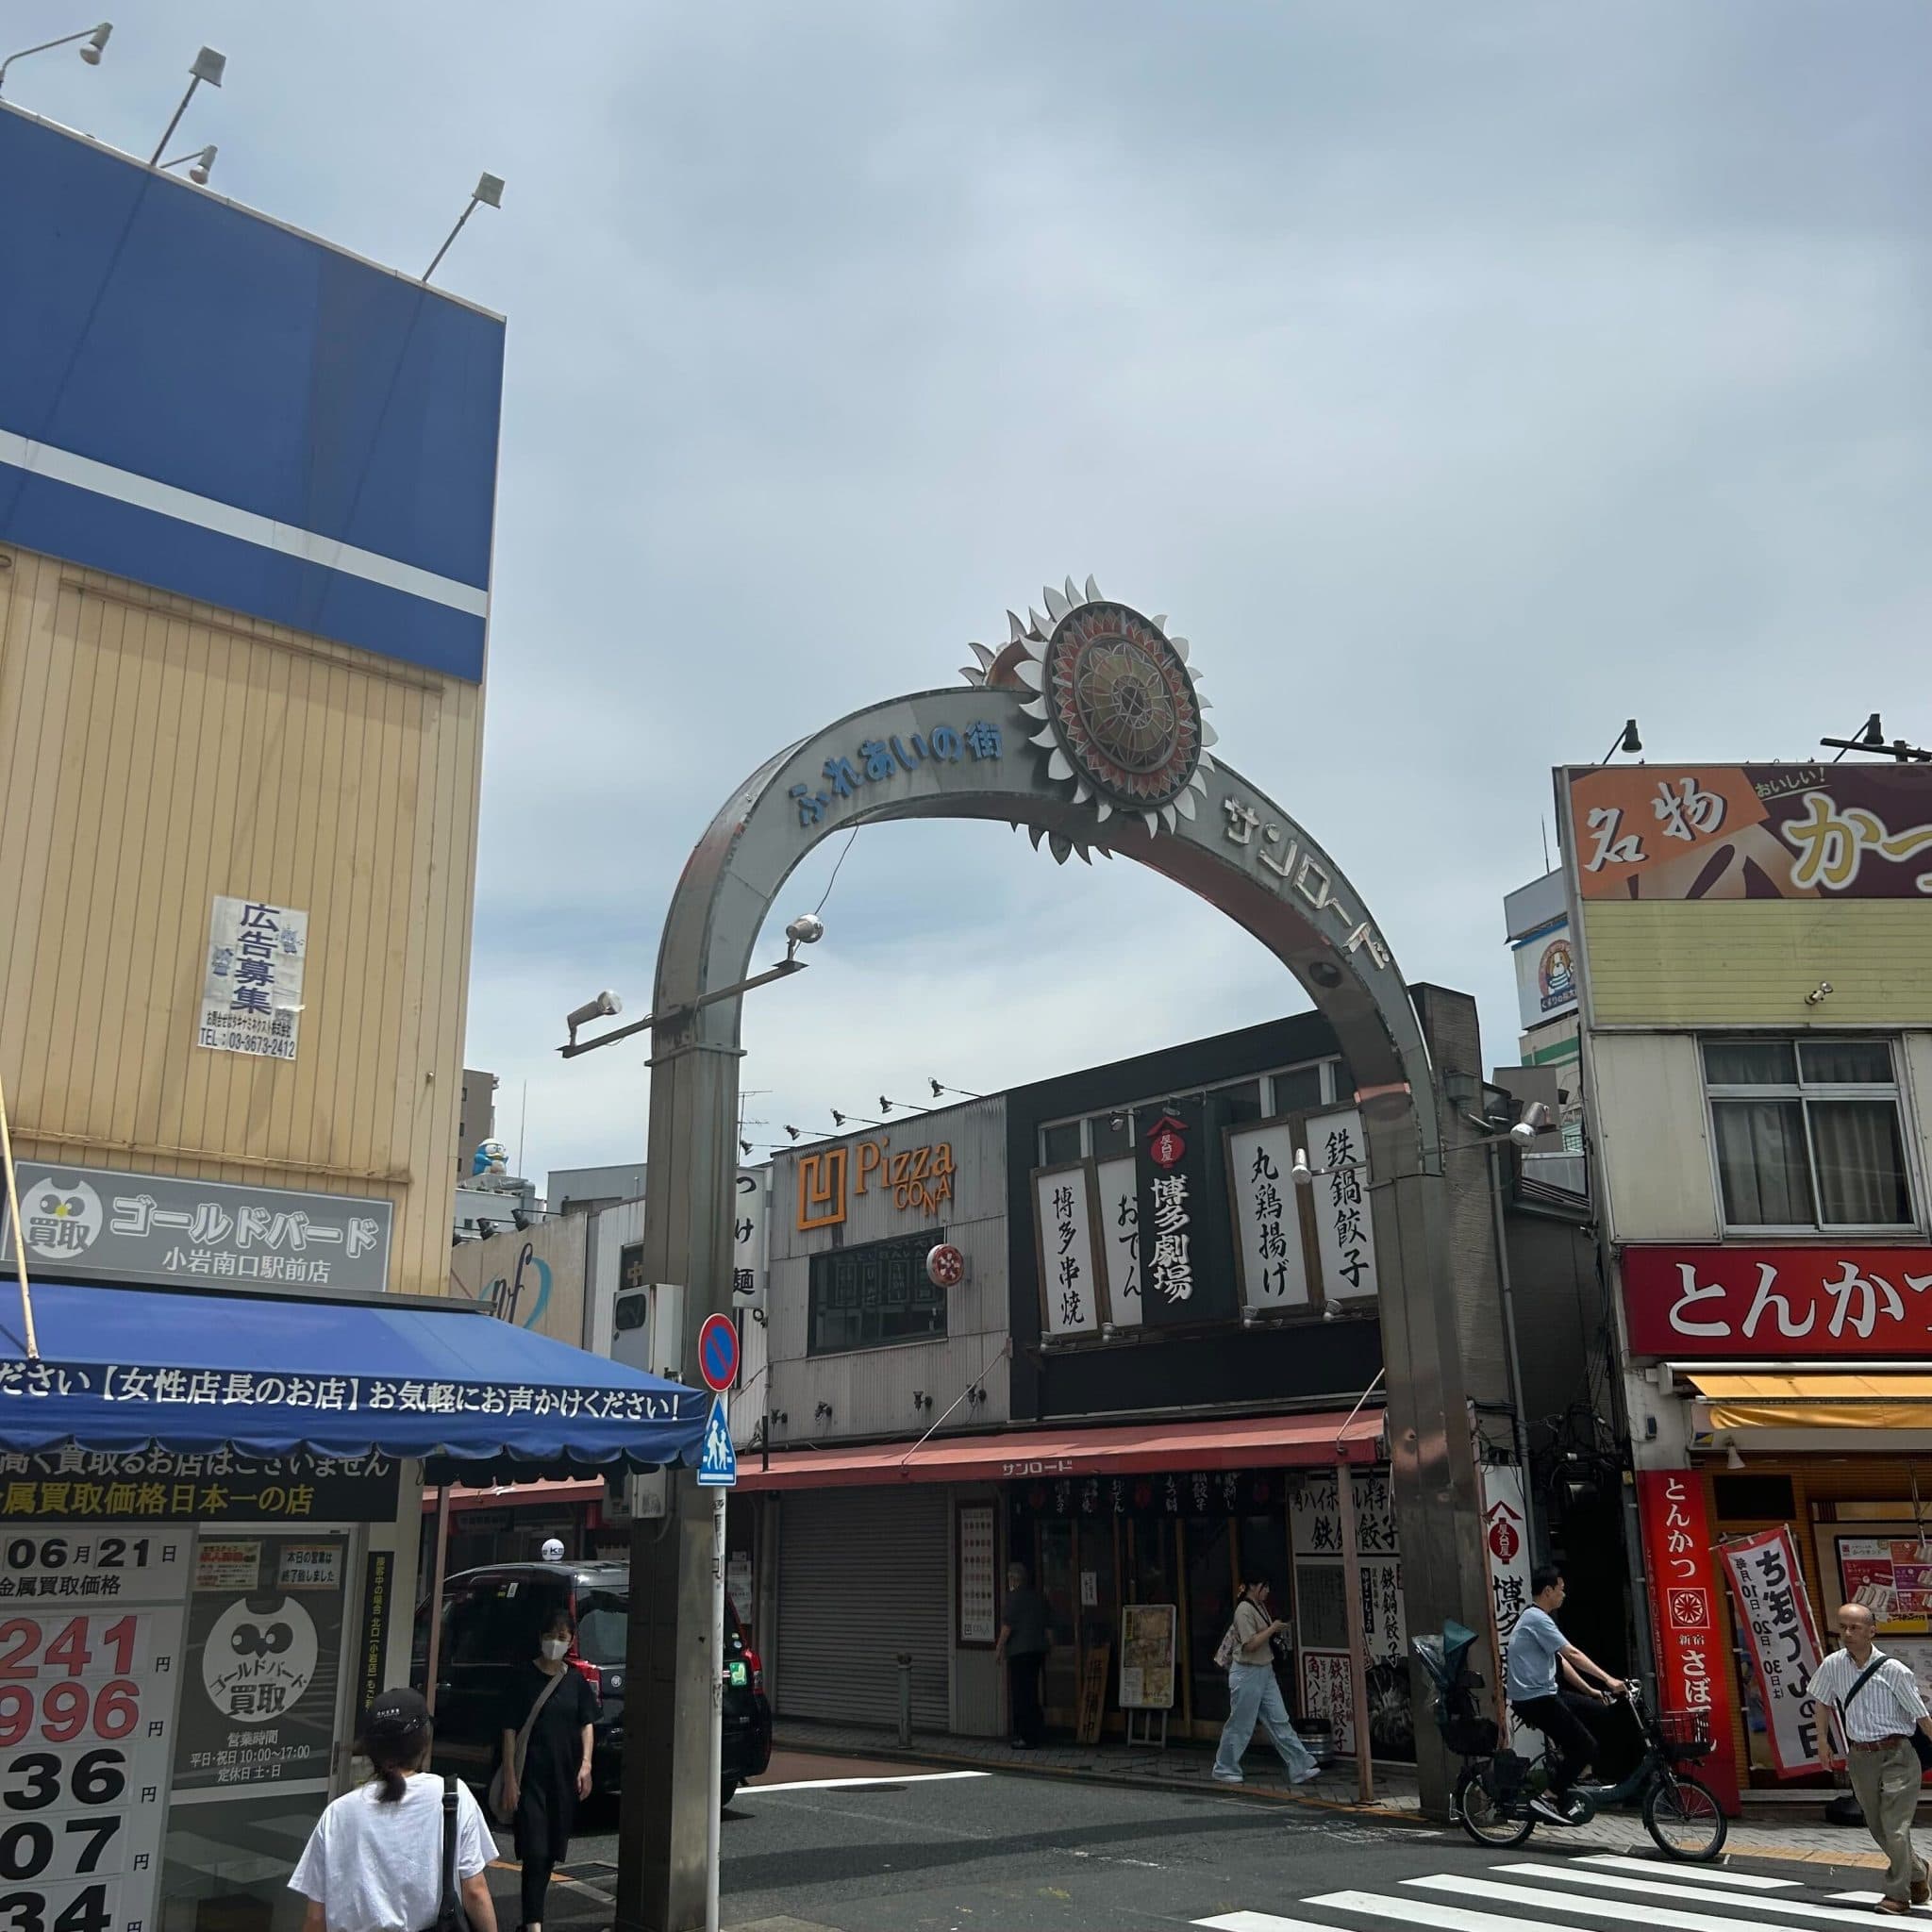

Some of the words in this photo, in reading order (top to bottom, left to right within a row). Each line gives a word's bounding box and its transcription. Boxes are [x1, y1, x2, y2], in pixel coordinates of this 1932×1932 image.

[789, 720, 1003, 826] ふれあいの街
[1756, 767, 1826, 798] おいしい!
[1584, 776, 1727, 873] 名物
[1224, 795, 1391, 970] サンロード
[230, 903, 280, 1016] 広告募集
[853, 1134, 957, 1196] Pizza
[895, 1177, 953, 1217] CONA
[27, 1217, 89, 1250] 買取
[110, 1194, 379, 1259] ゴールドバード
[732, 1175, 757, 1296] つけ麺
[1149, 1174, 1194, 1305] 博多劇場
[1251, 1145, 1290, 1297] 丸鶏揚げ
[1324, 1127, 1370, 1289] 鉄鍋餃子
[162, 1247, 332, 1284] 小岩南口駅前店
[1052, 1185, 1085, 1325] 博多串焼
[1117, 1192, 1142, 1299] おでん
[0, 1481, 315, 1515] 属買取価格日本一の店
[1002, 1459, 1074, 1476] サンロード
[1665, 1477, 1696, 1578] とんかつ
[0, 1574, 122, 1597] 金属買取価格
[0, 1615, 138, 1679] 241
[155, 1656, 171, 1673] 円
[208, 1659, 308, 1697] ゴールドバード
[0, 1679, 141, 1746] 996
[148, 1720, 164, 1738] 円
[226, 1683, 287, 1716] 買取
[227, 1729, 279, 1748] 営業時間
[3, 1748, 126, 1810] 36
[142, 1785, 158, 1803] 円
[0, 1815, 122, 1880] 07
[133, 1853, 150, 1872] 円
